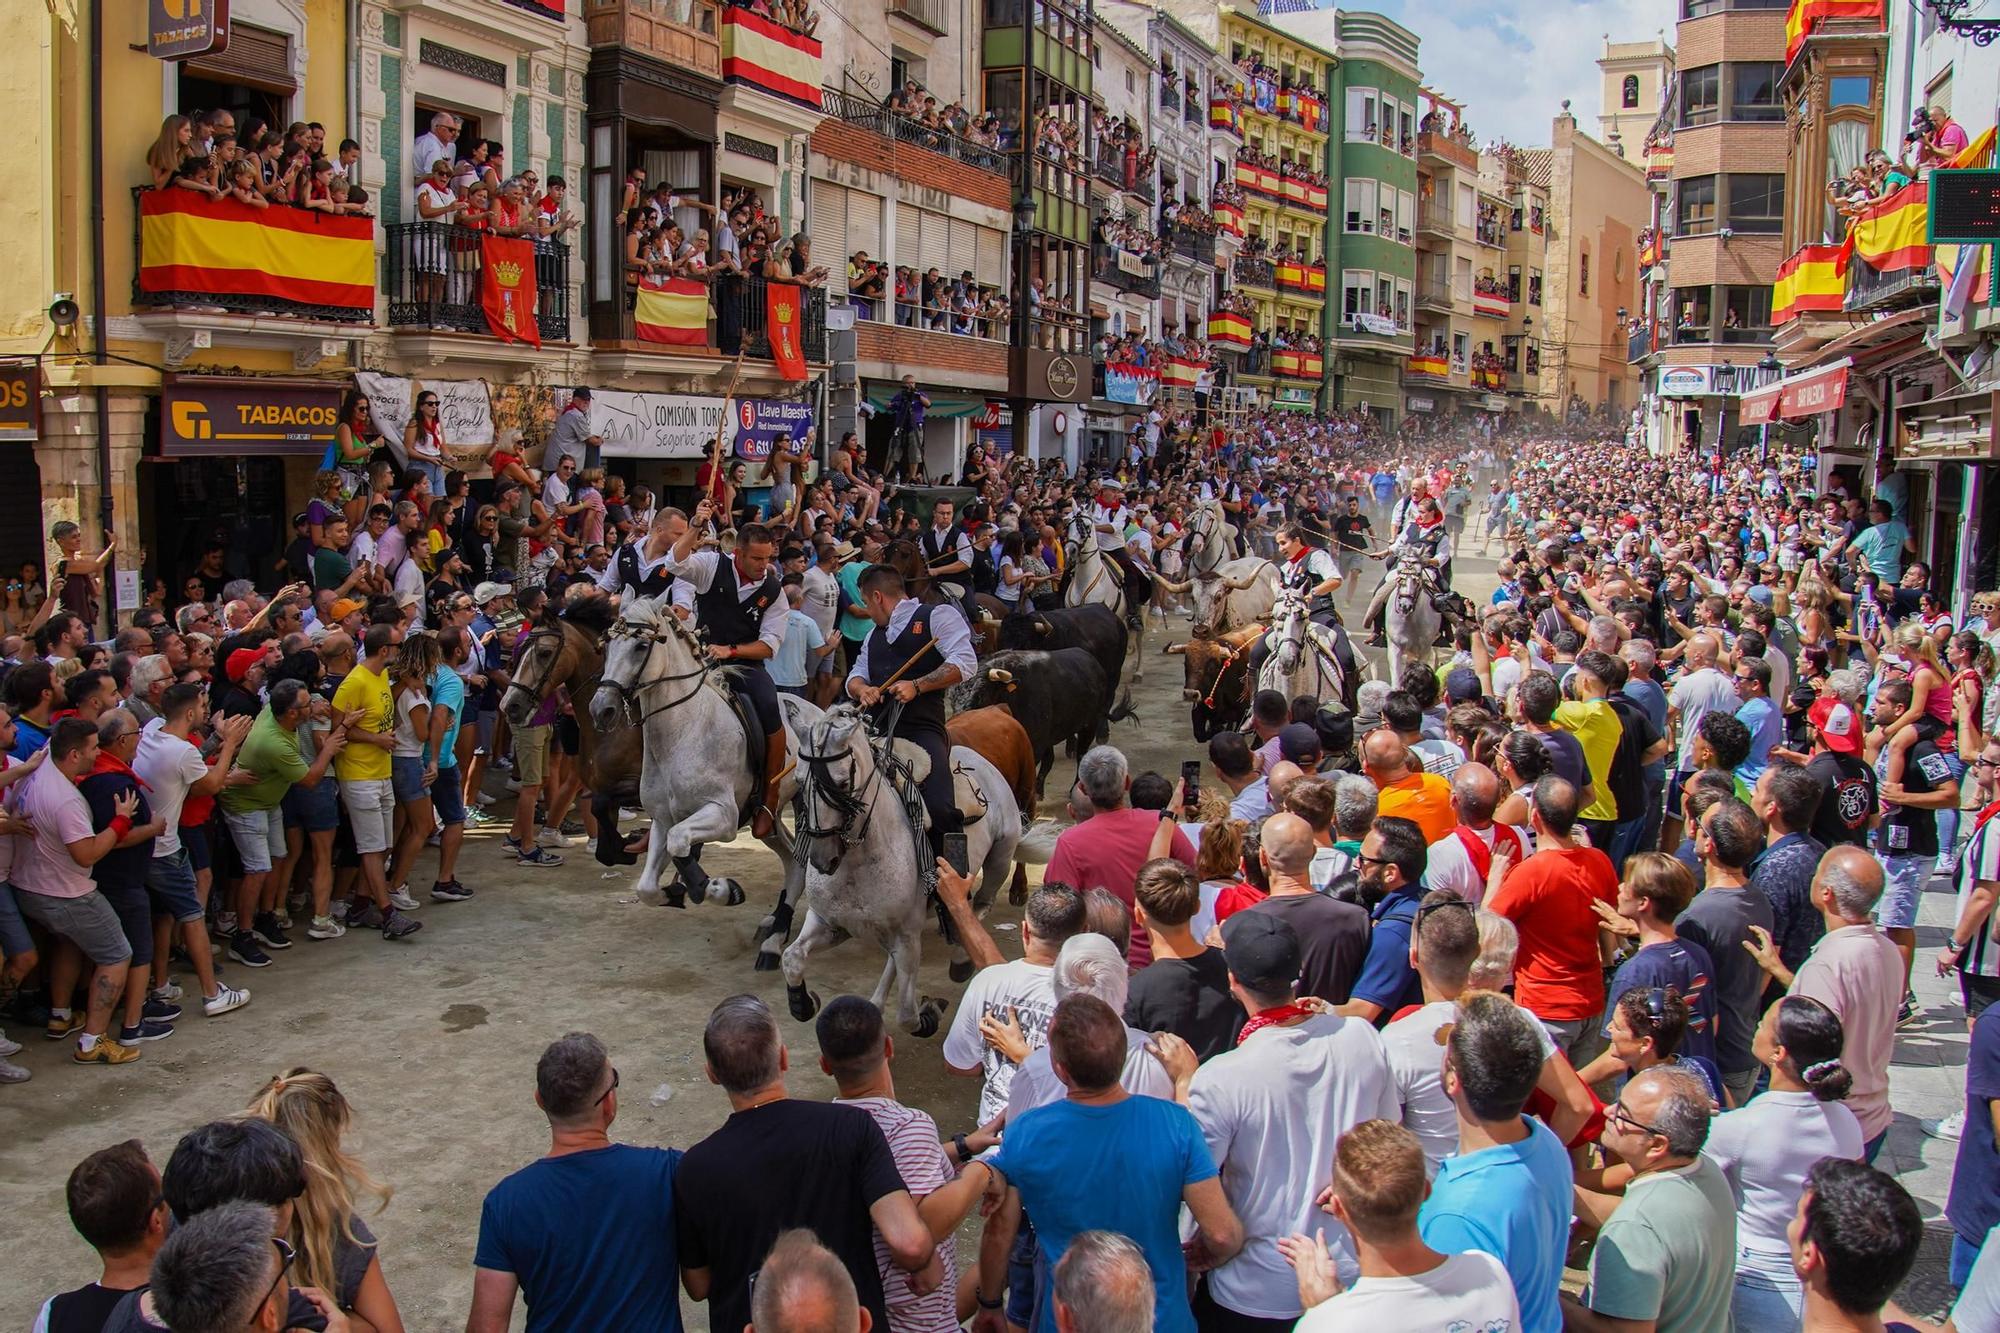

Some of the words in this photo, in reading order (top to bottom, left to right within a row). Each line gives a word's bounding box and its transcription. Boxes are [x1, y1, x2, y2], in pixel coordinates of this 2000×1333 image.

[153, 24, 207, 46] TABACOS
[237, 404, 337, 426] TABACOS
[655, 401, 697, 427] COMISIÓN
[757, 402, 780, 418] Llave
[655, 428, 696, 453] Segorbe
[699, 430, 730, 448] 203
